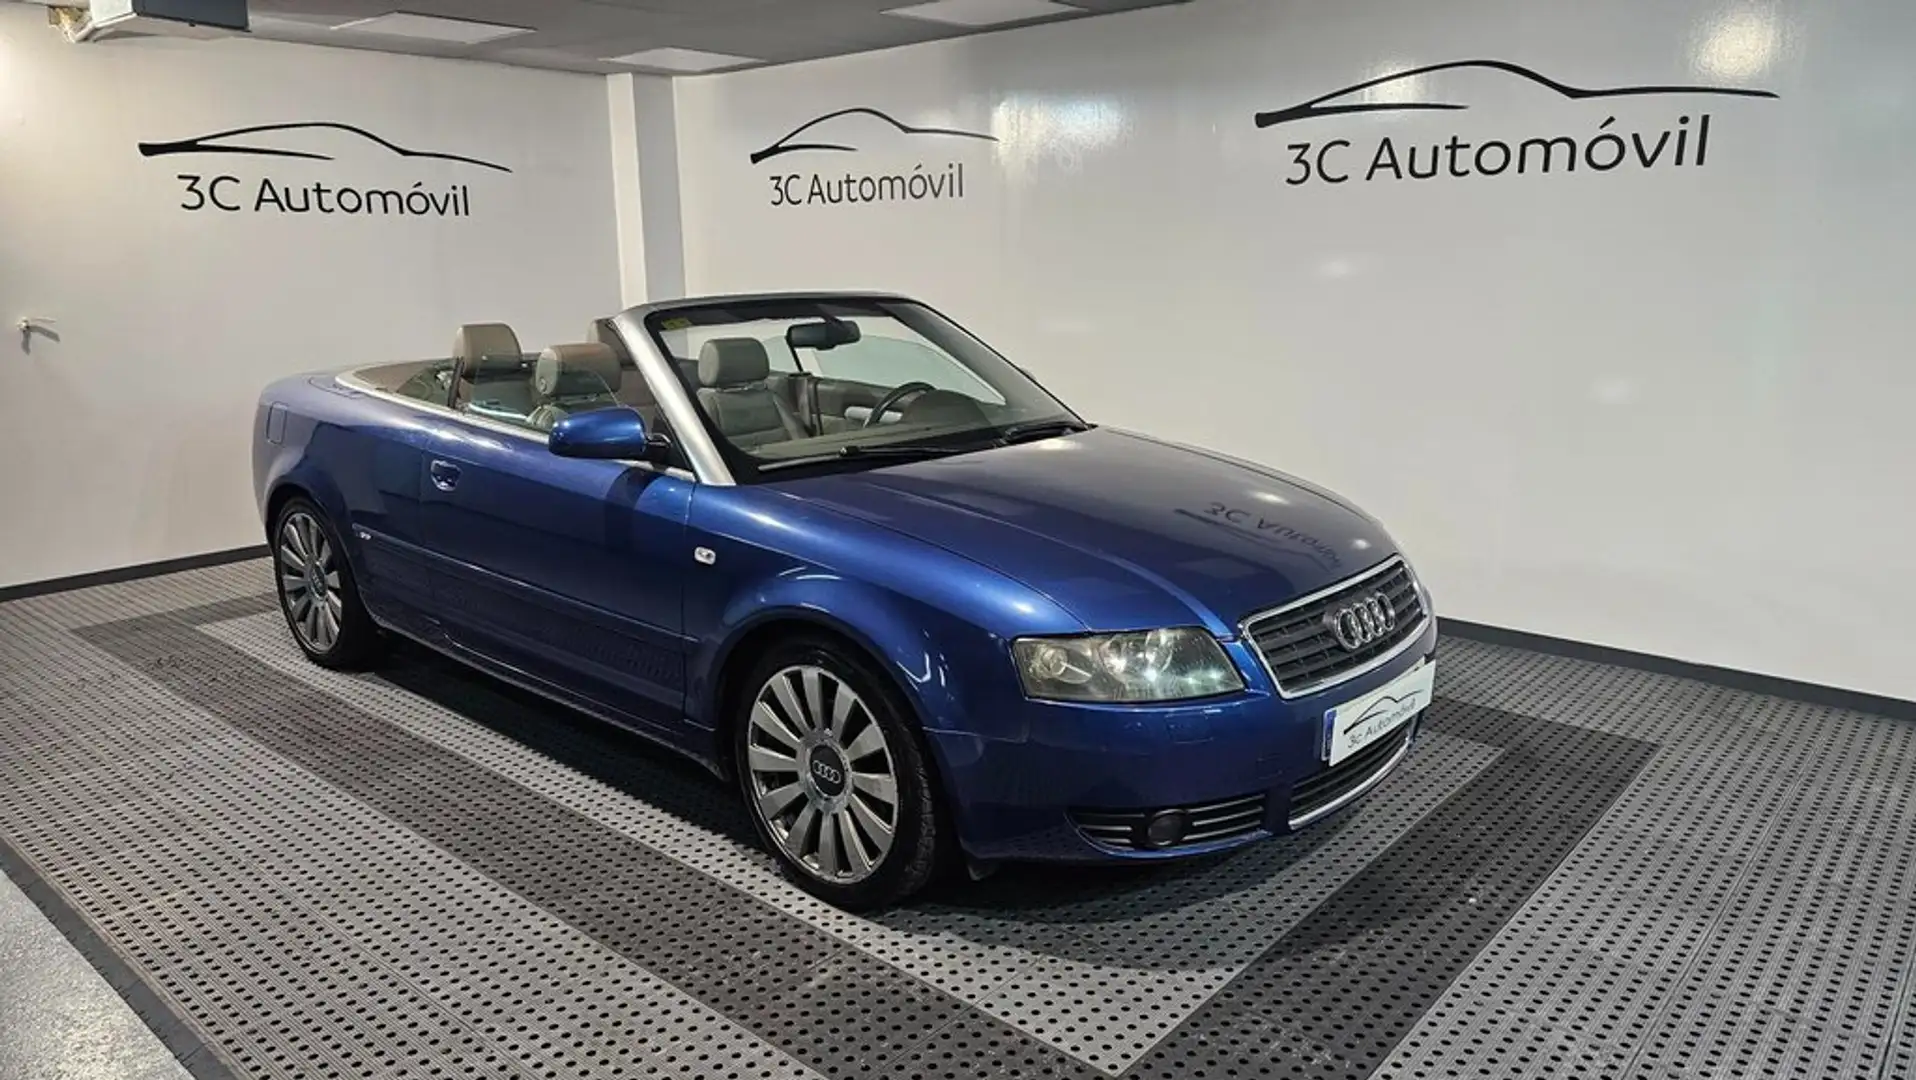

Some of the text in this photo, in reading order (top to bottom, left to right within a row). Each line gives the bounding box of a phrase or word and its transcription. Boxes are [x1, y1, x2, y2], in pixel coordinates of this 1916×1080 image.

[1284, 113, 1711, 187] 3C Automóvil
[177, 174, 470, 218] 3C Automóvil
[769, 162, 964, 206] 3C Automóvil
